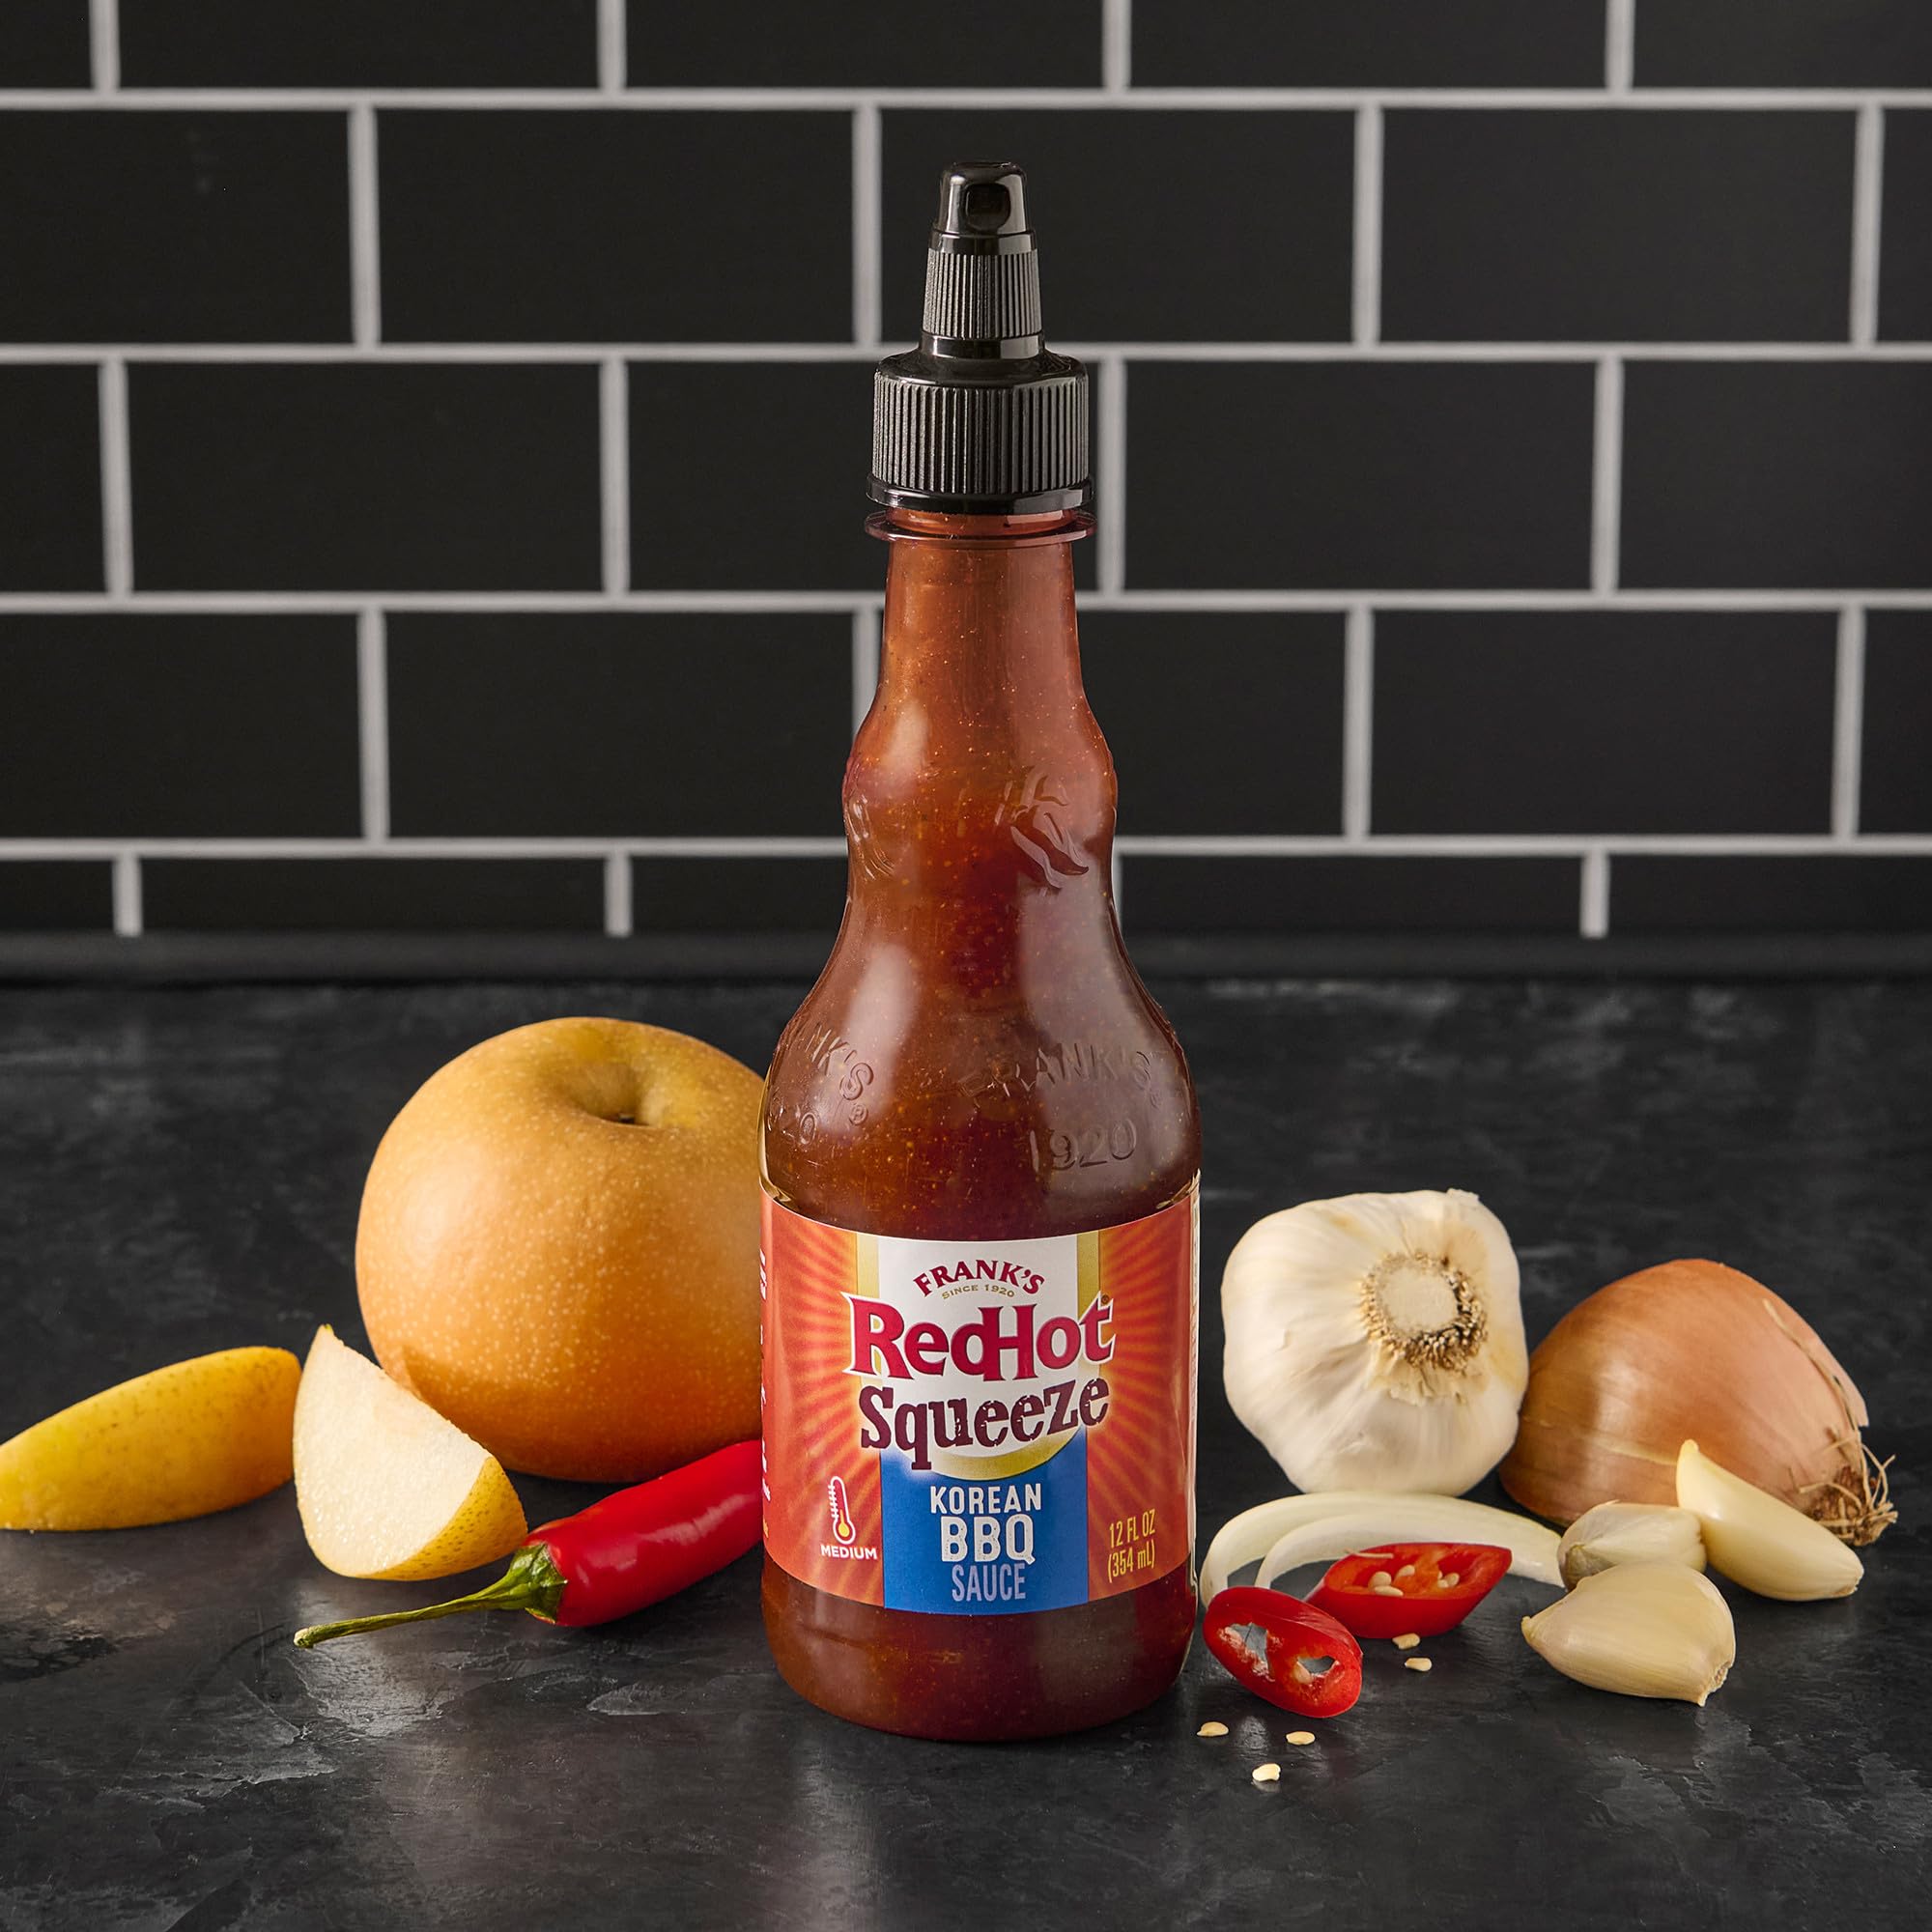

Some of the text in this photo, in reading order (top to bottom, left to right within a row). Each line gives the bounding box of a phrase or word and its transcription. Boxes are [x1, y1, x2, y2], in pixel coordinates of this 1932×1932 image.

[1029, 1118, 1137, 1173] 1920
[913, 1259, 1045, 1297] FRANK'S
[942, 1284, 1015, 1299] SINCE 1920
[846, 1294, 1114, 1382] RedHot
[859, 1378, 1110, 1470] Squeeze
[930, 1483, 1041, 1515] KOREAN
[941, 1513, 1036, 1565] BBQ
[1109, 1508, 1155, 1548] 12 FL OZ
[820, 1545, 877, 1559] MEDIUM
[1107, 1539, 1155, 1583] (354 mL)
[952, 1563, 1026, 1602] SAUCE
